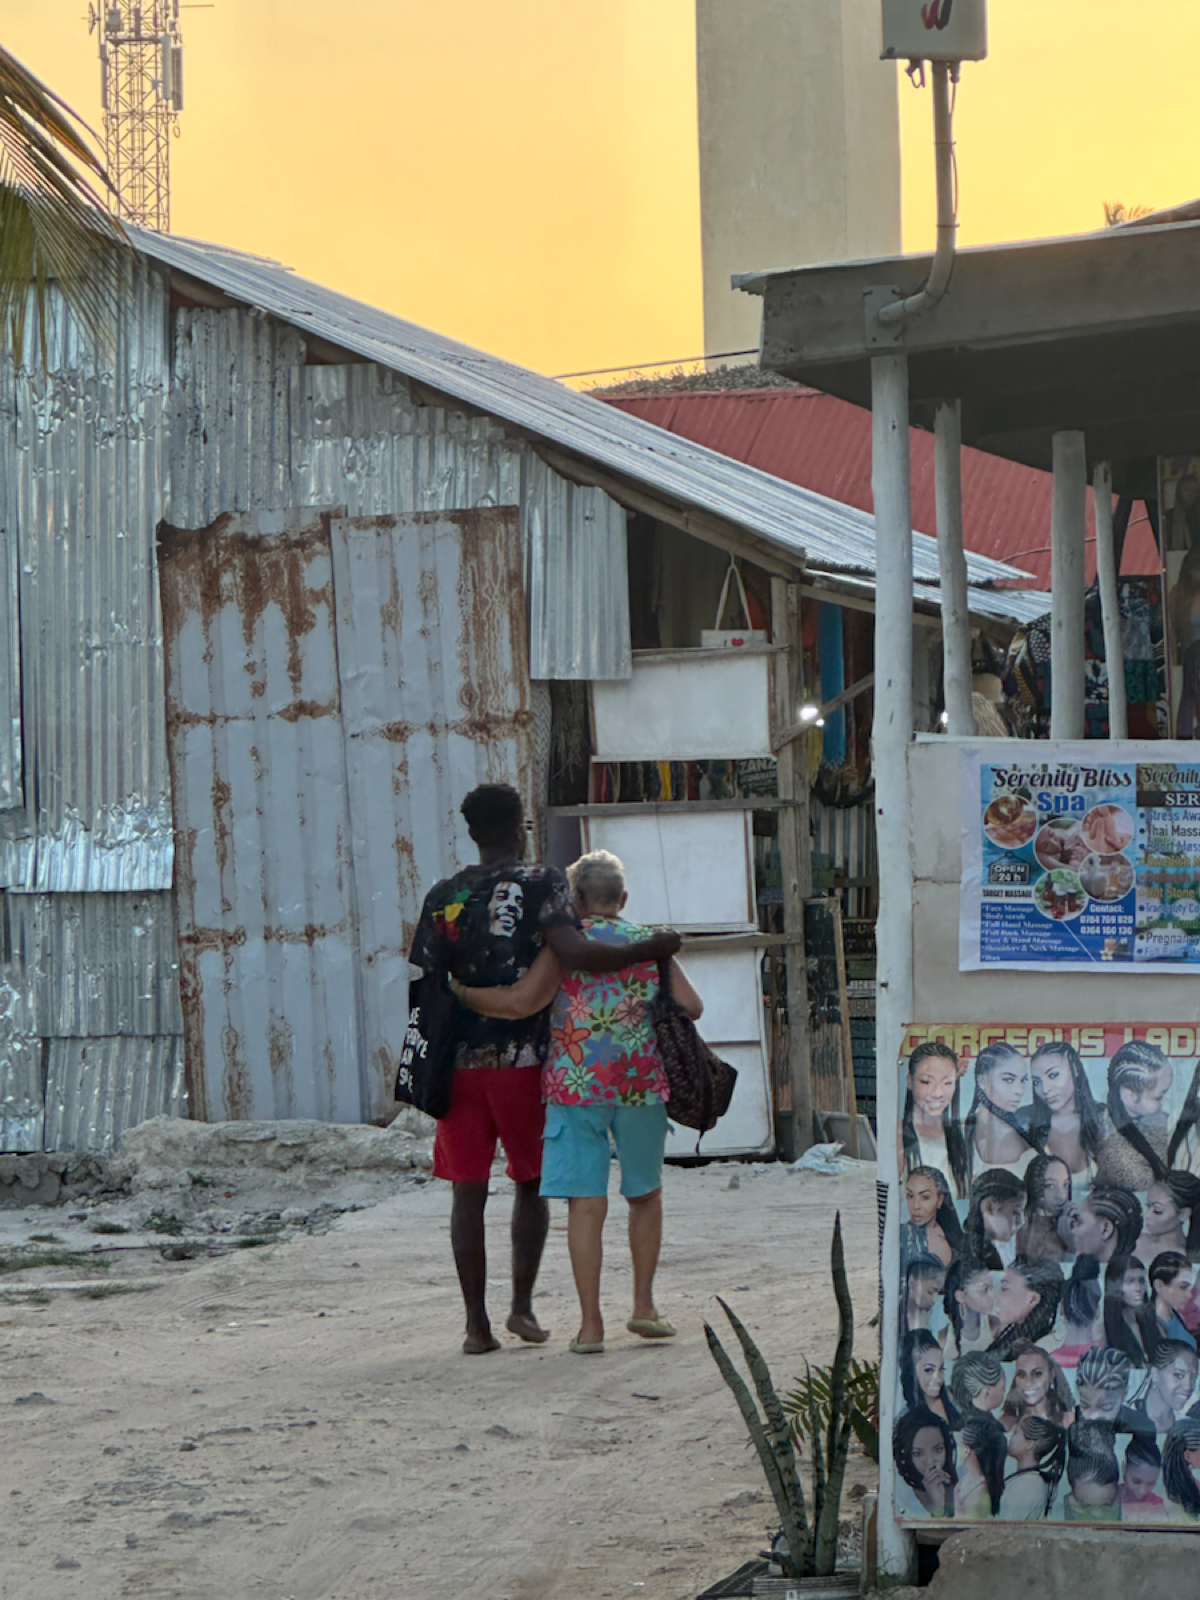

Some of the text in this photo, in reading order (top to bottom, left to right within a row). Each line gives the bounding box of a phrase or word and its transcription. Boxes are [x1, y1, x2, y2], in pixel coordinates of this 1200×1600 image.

[990, 767, 1132, 793] Serenity Bliss
[1037, 791, 1085, 813] Spa
[1164, 792, 1200, 806] SER
[994, 865, 1025, 873] OPEN
